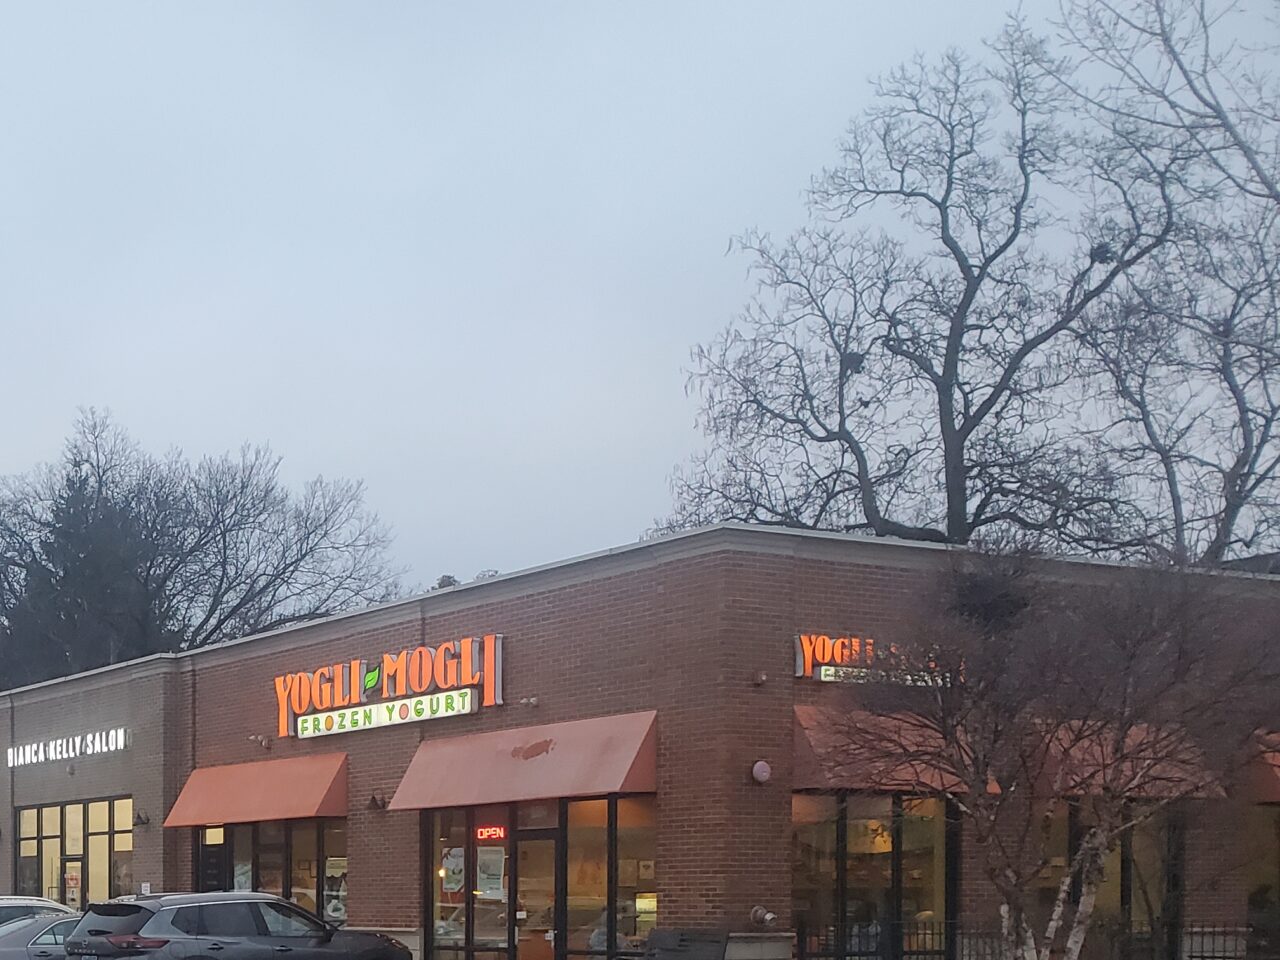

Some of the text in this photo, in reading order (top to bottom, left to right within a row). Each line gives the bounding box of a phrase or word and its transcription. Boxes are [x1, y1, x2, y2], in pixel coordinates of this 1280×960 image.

[274, 634, 504, 737] YOGLI MOGLI
[299, 691, 469, 736] FROZEN YOGURT
[7, 727, 125, 768] BIANCA KELLY SALON
[477, 826, 505, 840] OPEN
